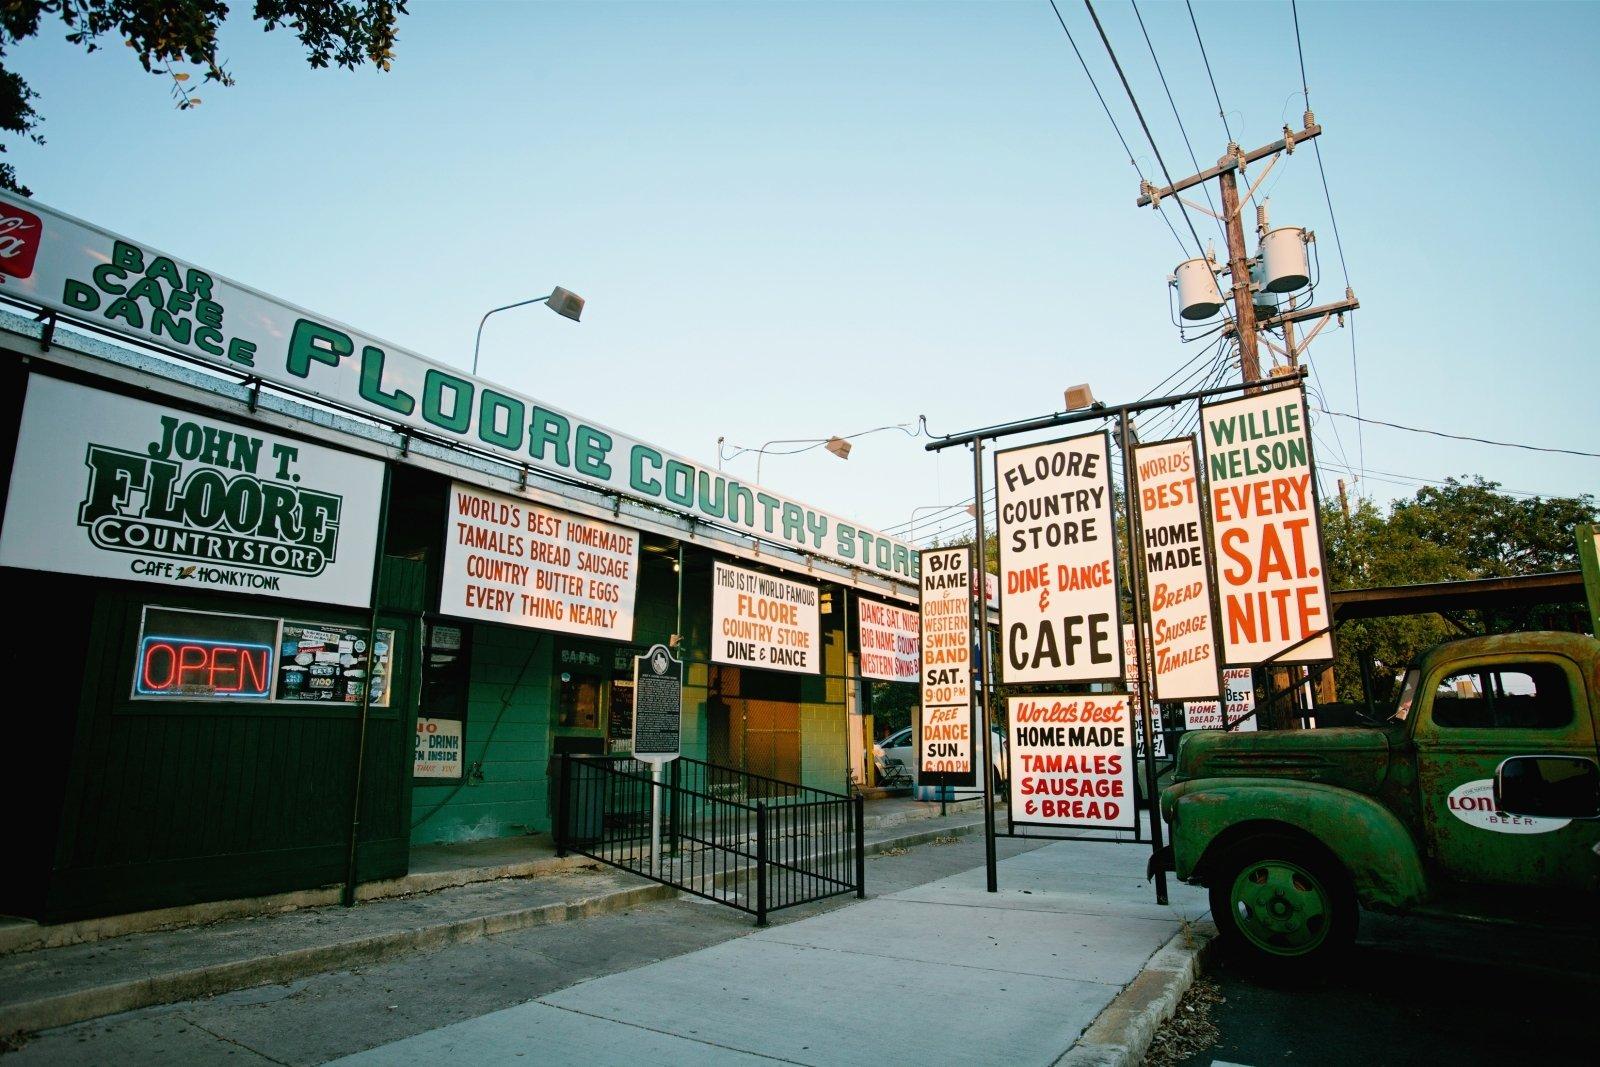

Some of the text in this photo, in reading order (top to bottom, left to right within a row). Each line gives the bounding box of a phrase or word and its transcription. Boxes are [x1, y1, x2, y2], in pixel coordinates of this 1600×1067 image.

[112, 240, 213, 301] BAR
[93, 263, 224, 329] CAFE
[63, 278, 256, 368] DANCE
[1209, 403, 1301, 447] WILLIE
[148, 415, 301, 482] JOHN T.
[286, 318, 919, 579] FLOORE COUNTRY STORE
[1210, 438, 1307, 481] NELSON
[1004, 451, 1100, 493] FLOORE
[1139, 451, 1190, 482] WORLD'S
[78, 443, 342, 563] FLOORE
[1003, 486, 1104, 525] COUNTRY
[1143, 477, 1195, 511] BEST
[1214, 474, 1311, 522] EVERY
[457, 493, 633, 555] WORLD'S BEST HOMEMADE
[1012, 517, 1098, 553] STORE
[1145, 522, 1198, 548] HOME
[457, 523, 629, 580] TAMALES BREAD SAUSAGE
[929, 553, 961, 572] BIG
[1147, 547, 1202, 573] MADE
[1221, 518, 1320, 586] SAT.
[131, 559, 281, 591] CAFE HONKYTONK
[466, 555, 619, 603] COUNTRY BUTTER EGGS
[717, 567, 815, 607] THIS IS IT! WORLD FAMOUS
[925, 572, 967, 591] NAME
[1007, 562, 1051, 595] DINE
[1057, 560, 1112, 593] DANCE
[465, 585, 618, 629] EVERY THING NEARLY
[738, 594, 798, 626] FLOORE
[924, 598, 968, 616] COUNTRY
[942, 591, 949, 599] &
[1038, 588, 1050, 613] &
[1152, 582, 1203, 612] BREAD
[861, 602, 885, 626] DANCE
[902, 612, 919, 634] NIGH
[924, 616, 967, 632] WESTERN
[1154, 615, 1207, 646] SAUSAGE
[1226, 586, 1323, 645] NITE
[722, 618, 810, 649] COUNTRY STORE
[861, 627, 874, 649] BIG
[876, 630, 895, 652] NAME
[927, 632, 966, 648] SWING
[1009, 613, 1113, 671] CAFE
[144, 644, 267, 692] OPEN
[727, 640, 807, 668] DINE & DANCE
[861, 652, 893, 676] WESTERN
[895, 657, 914, 677] SWING
[925, 648, 967, 665] BAND
[1156, 644, 1210, 674] TAMALES
[927, 668, 964, 686] SAT.
[1224, 670, 1249, 679] ANCE
[925, 687, 951, 702] 9:00
[1189, 704, 1249, 715] HOME ADE
[929, 707, 958, 725] FREE
[1080, 700, 1124, 723] Best
[429, 735, 458, 749] DRINK
[924, 724, 968, 741] DANCE
[428, 751, 457, 761] INSIDE
[927, 742, 964, 757] SUN.
[1020, 754, 1122, 775] TAMALES
[1021, 777, 1124, 798] SAUSAGE
[1025, 800, 1120, 820] & BREAD
[1489, 816, 1533, 825] BEER
